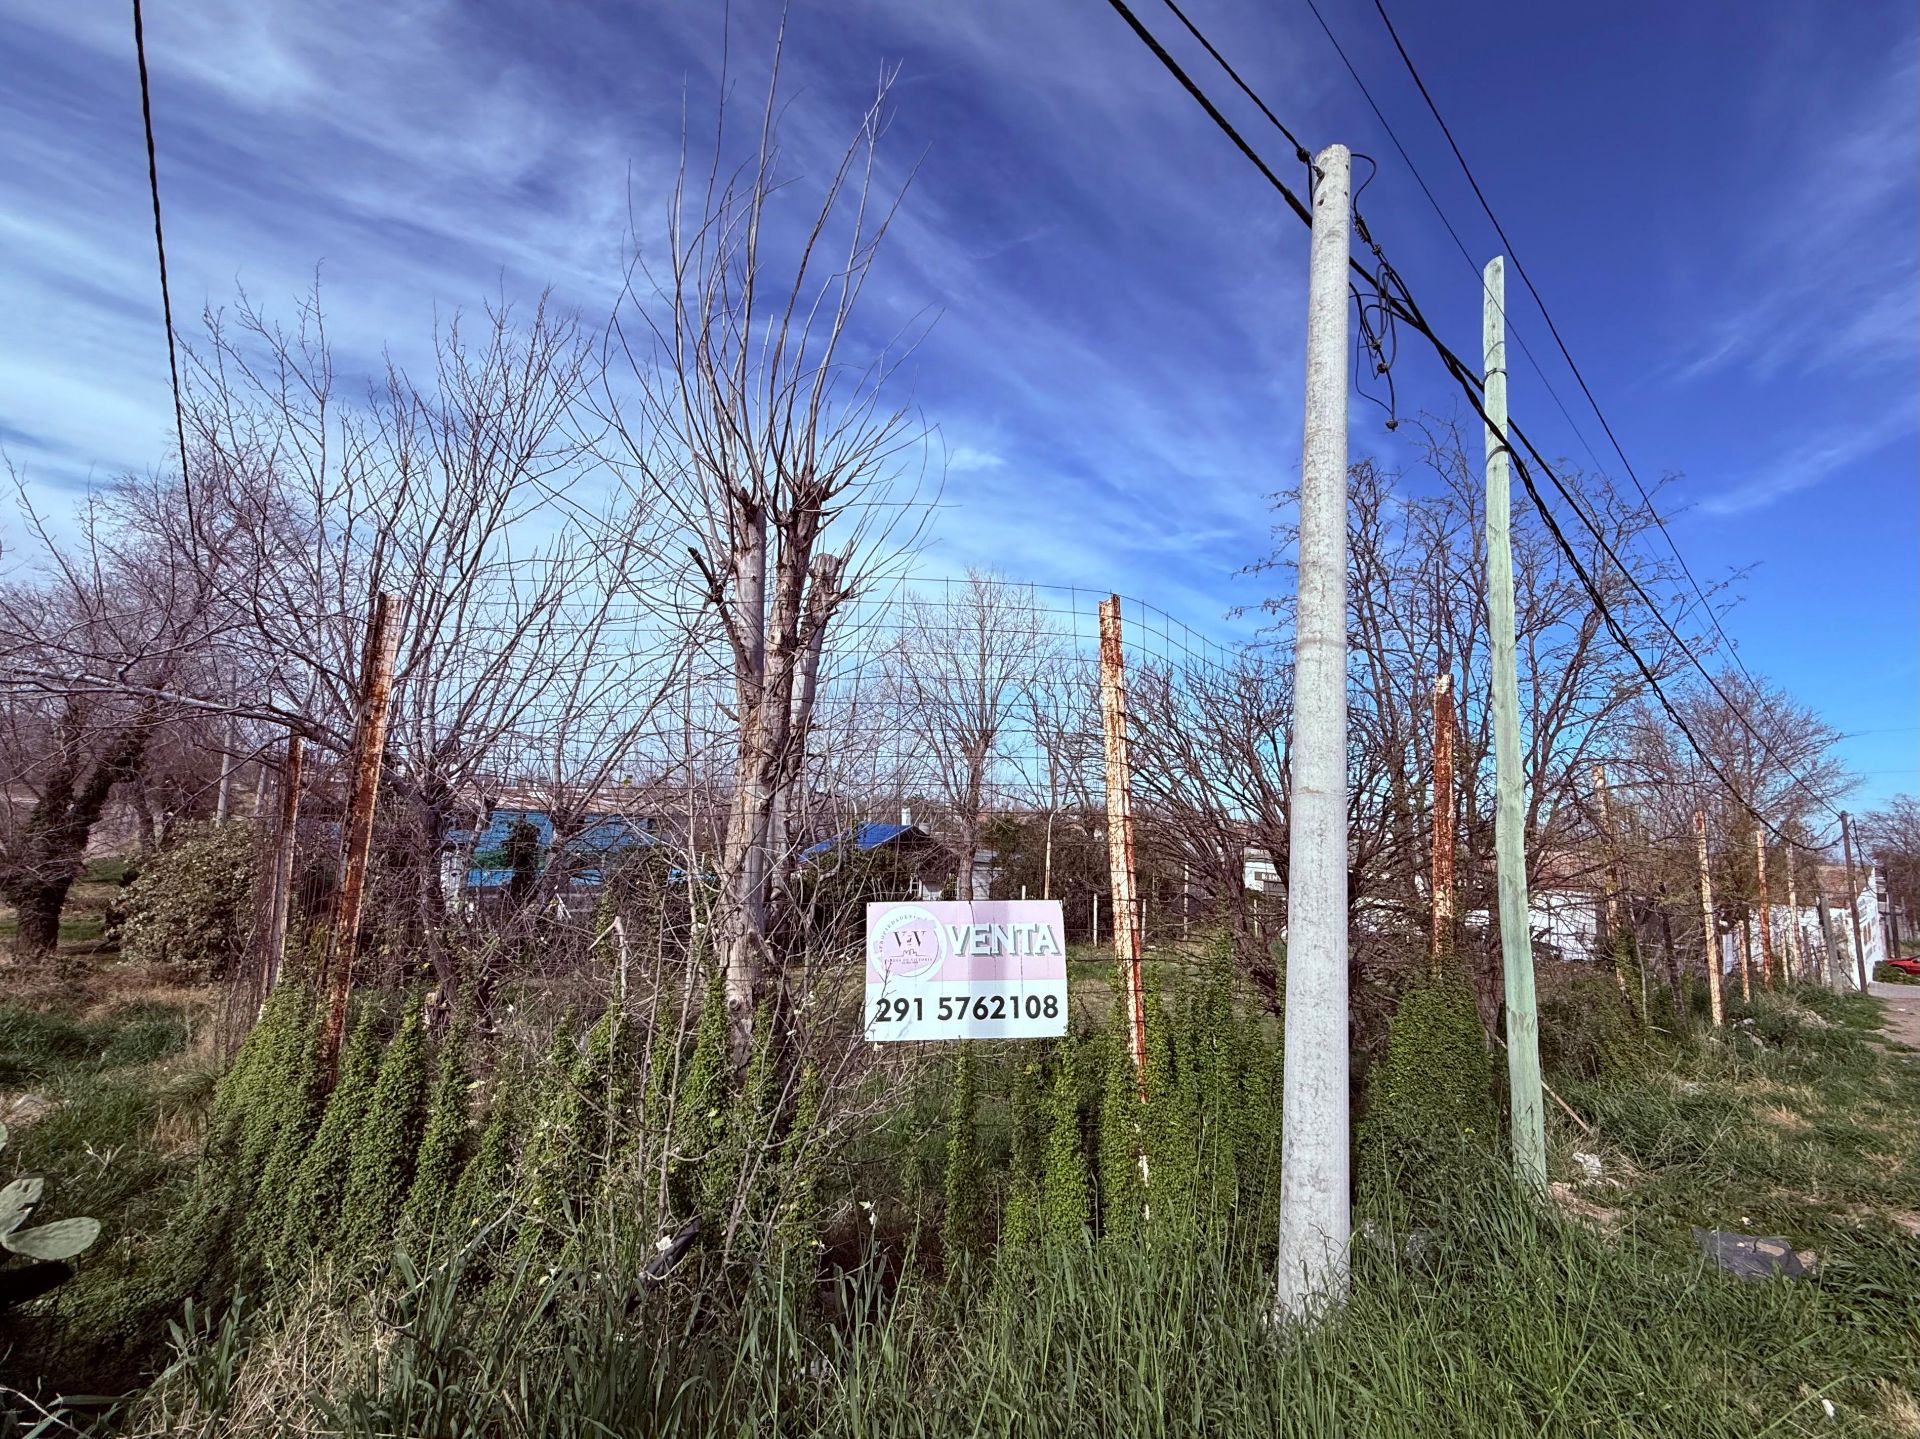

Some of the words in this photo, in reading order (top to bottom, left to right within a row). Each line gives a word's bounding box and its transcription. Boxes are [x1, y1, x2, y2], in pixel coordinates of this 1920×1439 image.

[945, 923, 1062, 957] VENTA
[876, 997, 924, 1022] 291
[937, 995, 1059, 1021] 5762108
